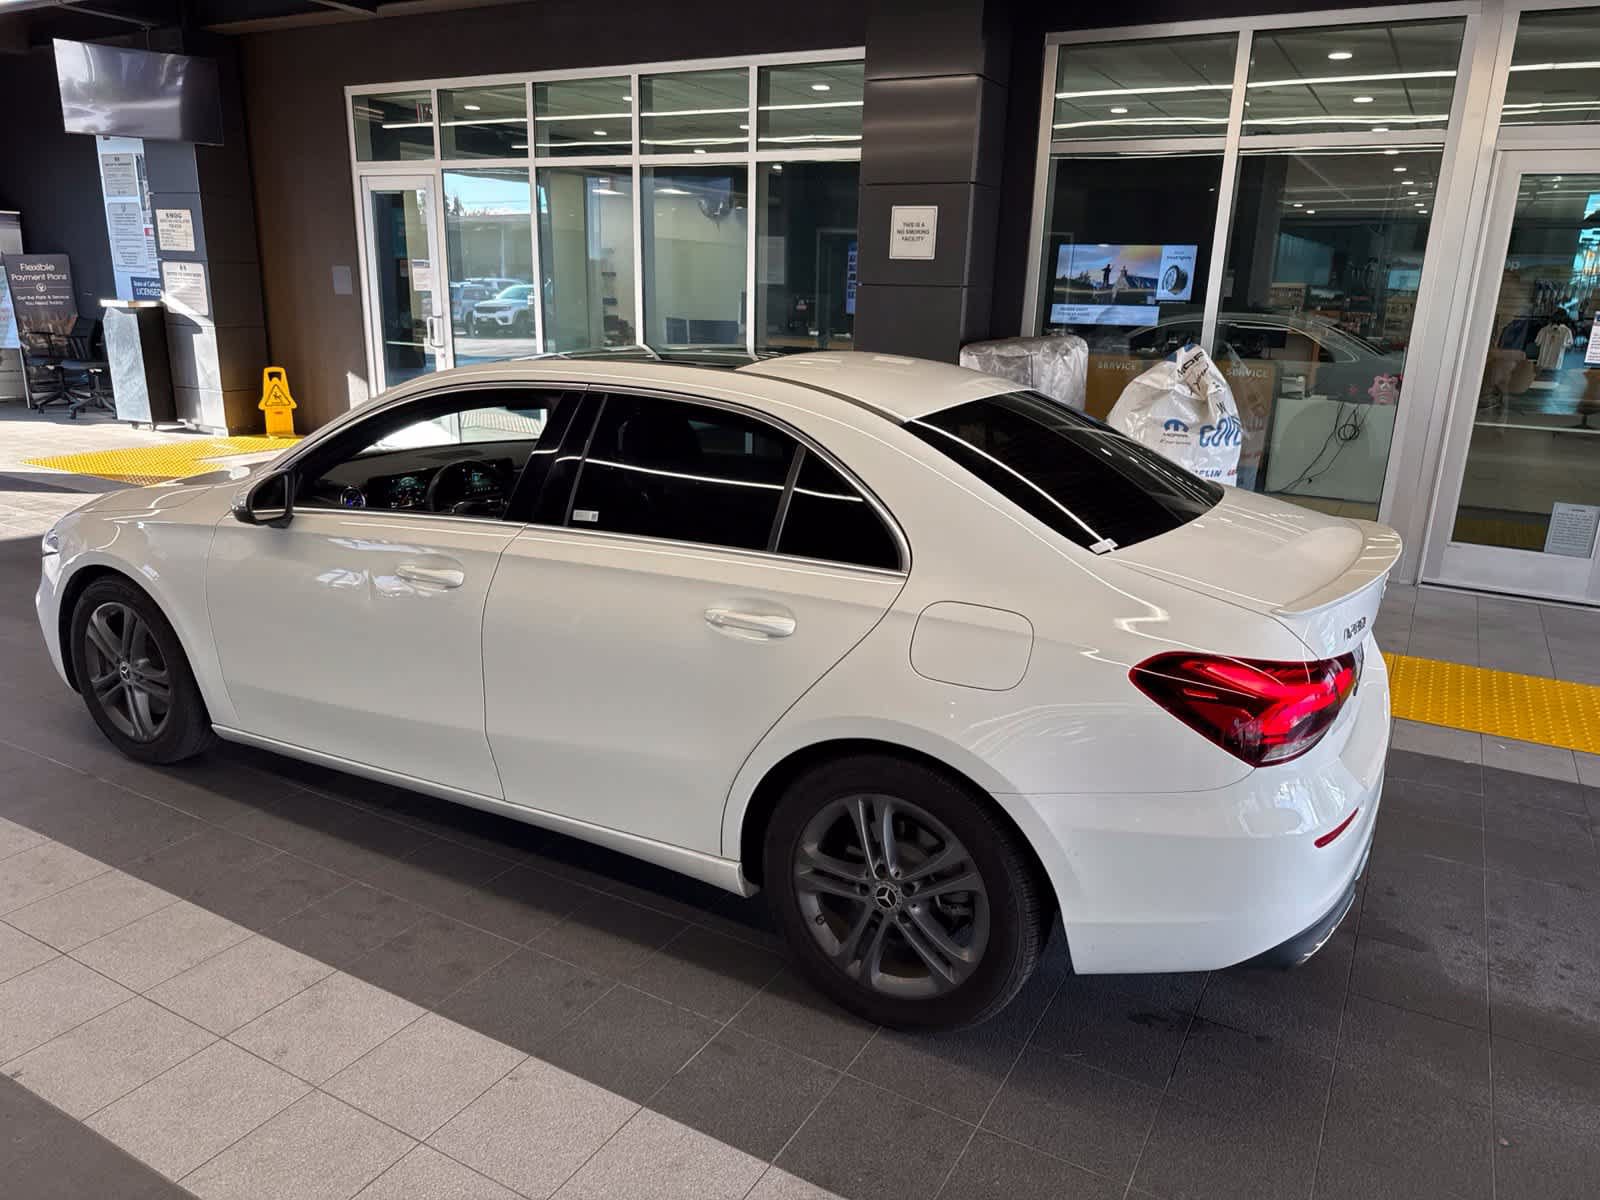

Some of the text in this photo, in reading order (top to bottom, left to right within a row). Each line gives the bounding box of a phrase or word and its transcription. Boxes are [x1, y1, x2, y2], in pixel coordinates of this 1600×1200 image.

[20, 263, 55, 271] Flexible
[10, 273, 68, 282] Payment Plans
